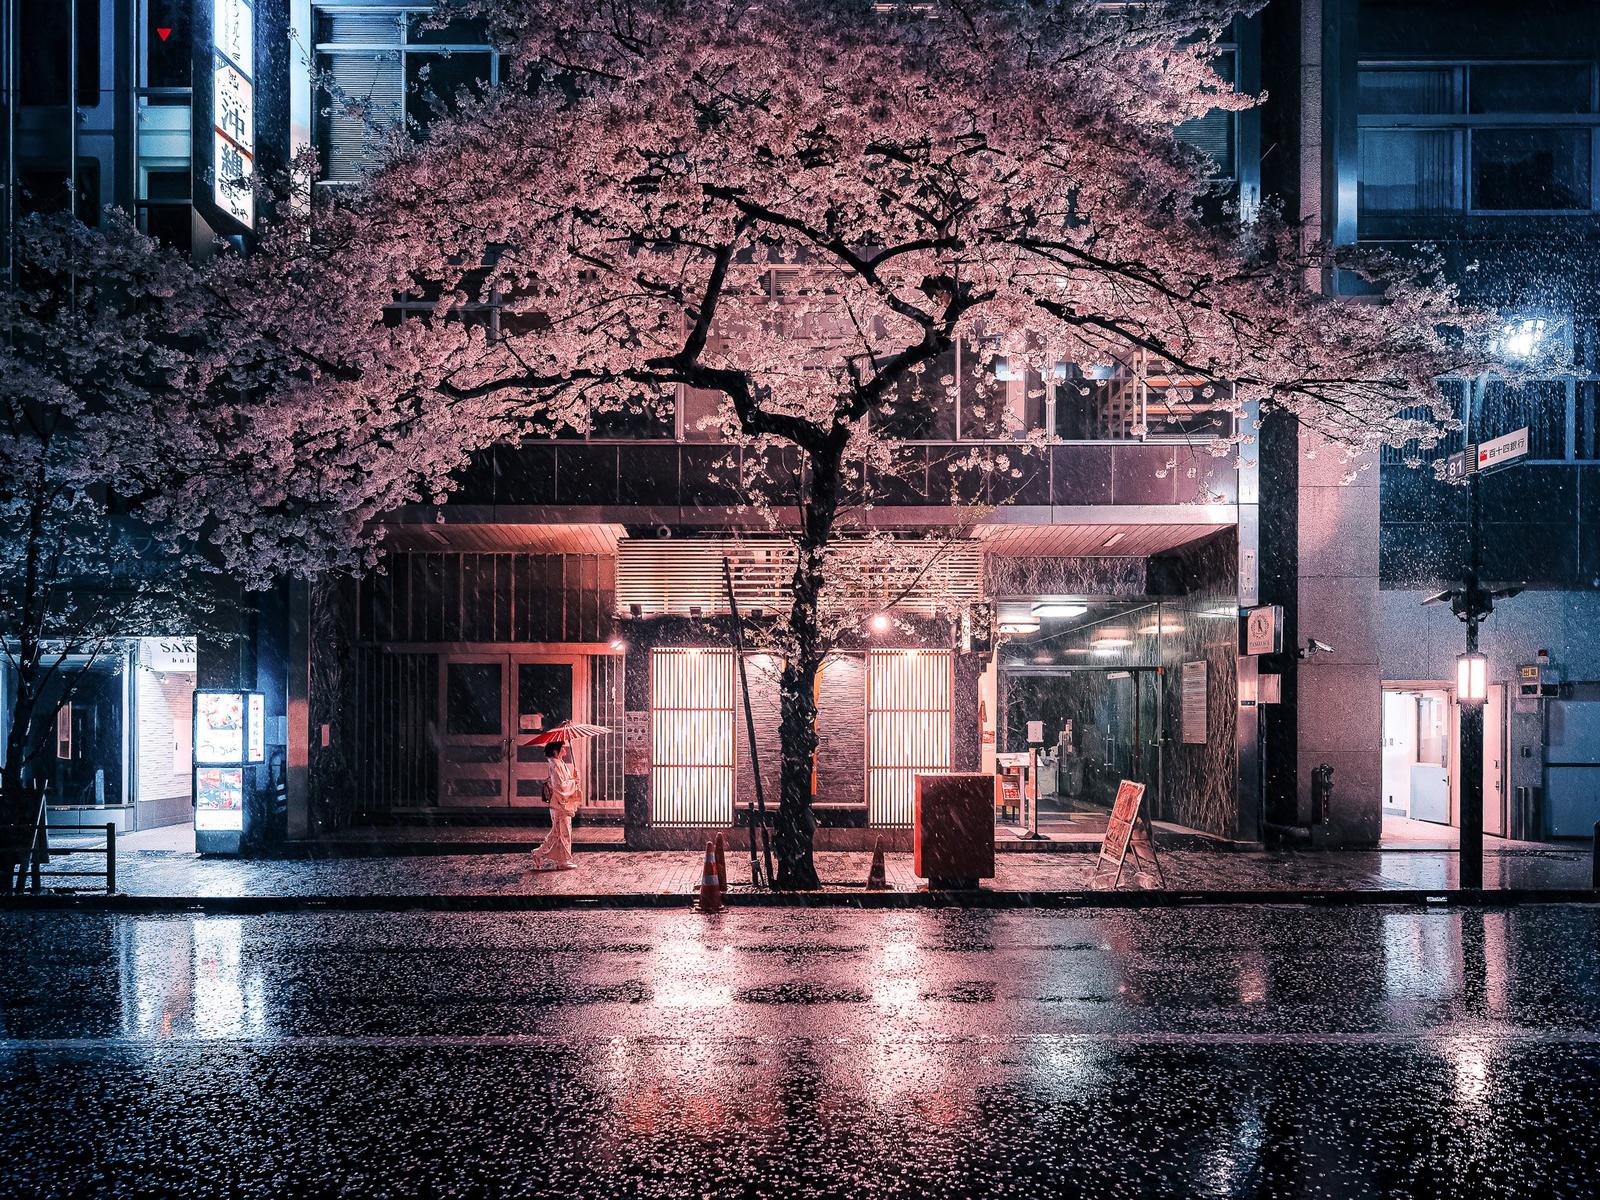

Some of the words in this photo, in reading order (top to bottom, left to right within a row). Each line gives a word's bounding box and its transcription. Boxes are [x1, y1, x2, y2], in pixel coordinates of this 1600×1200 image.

[221, 97, 246, 178] 沖縄
[1489, 438, 1525, 459] 百十四銀行
[1449, 459, 1462, 476] 81
